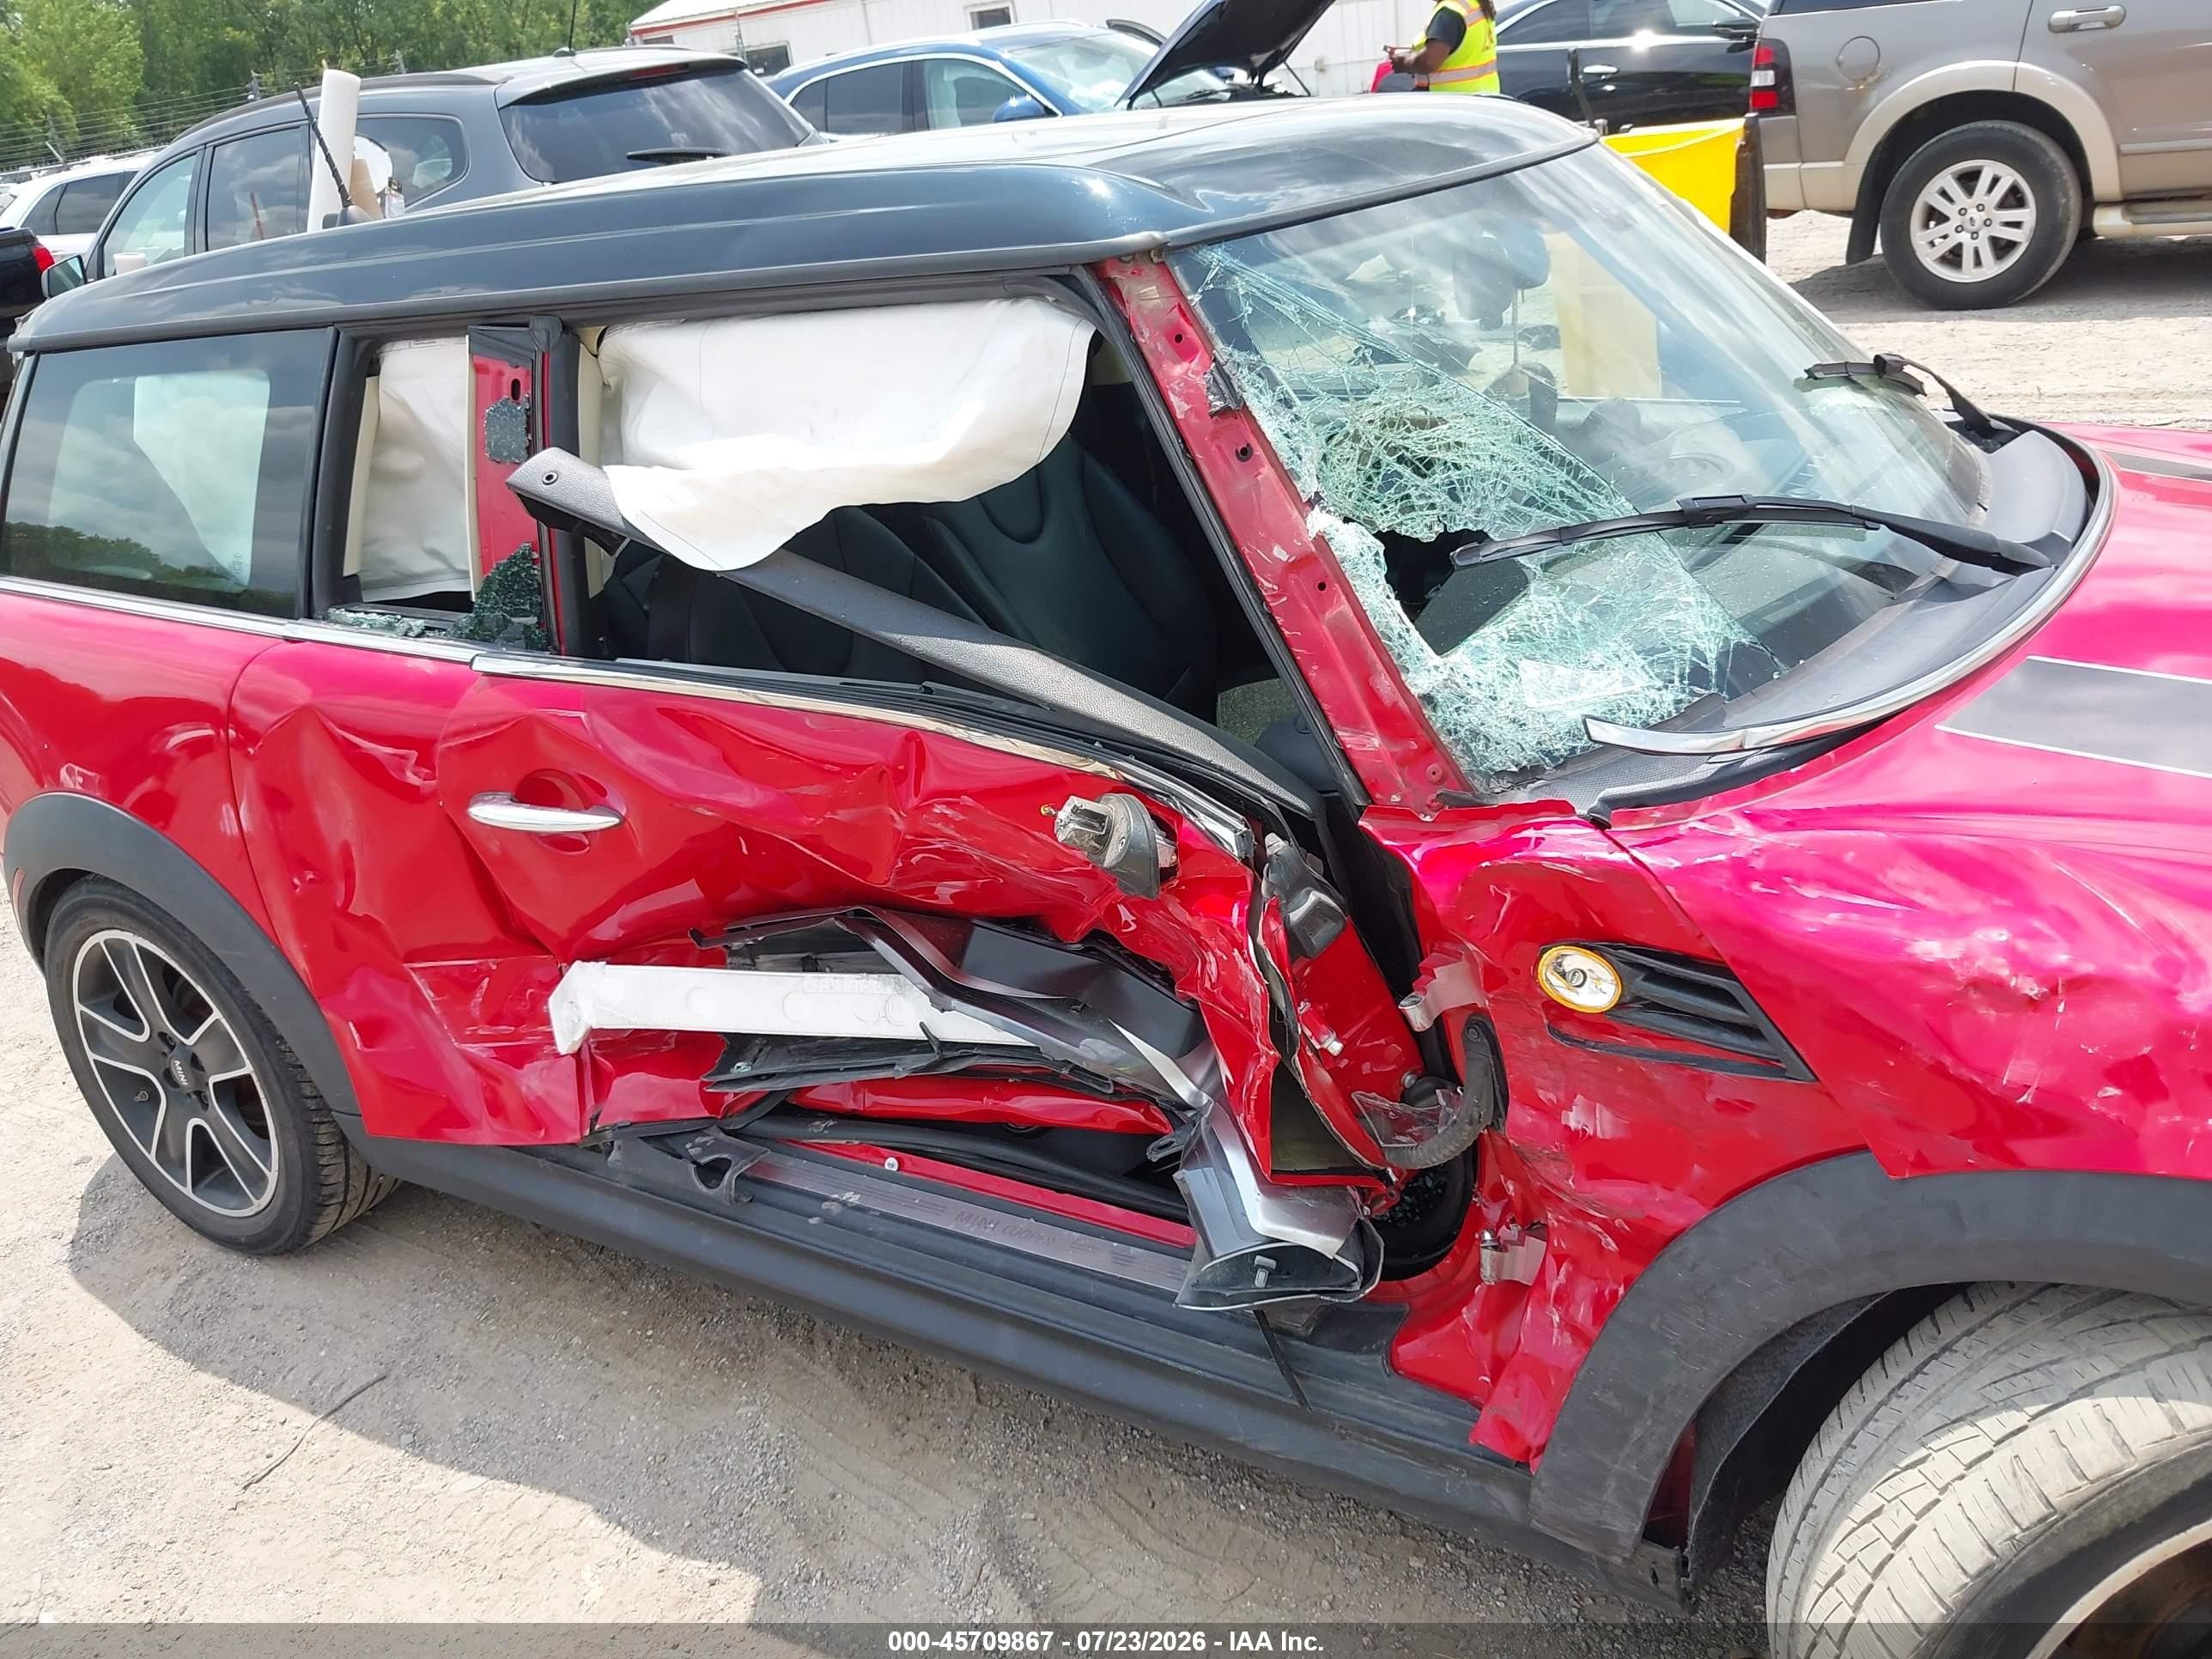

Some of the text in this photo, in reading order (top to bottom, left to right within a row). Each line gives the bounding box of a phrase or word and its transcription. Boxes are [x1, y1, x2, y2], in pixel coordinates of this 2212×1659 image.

[173, 1060, 189, 1086] MINI
[954, 1209, 1057, 1247] MINI COOPER
